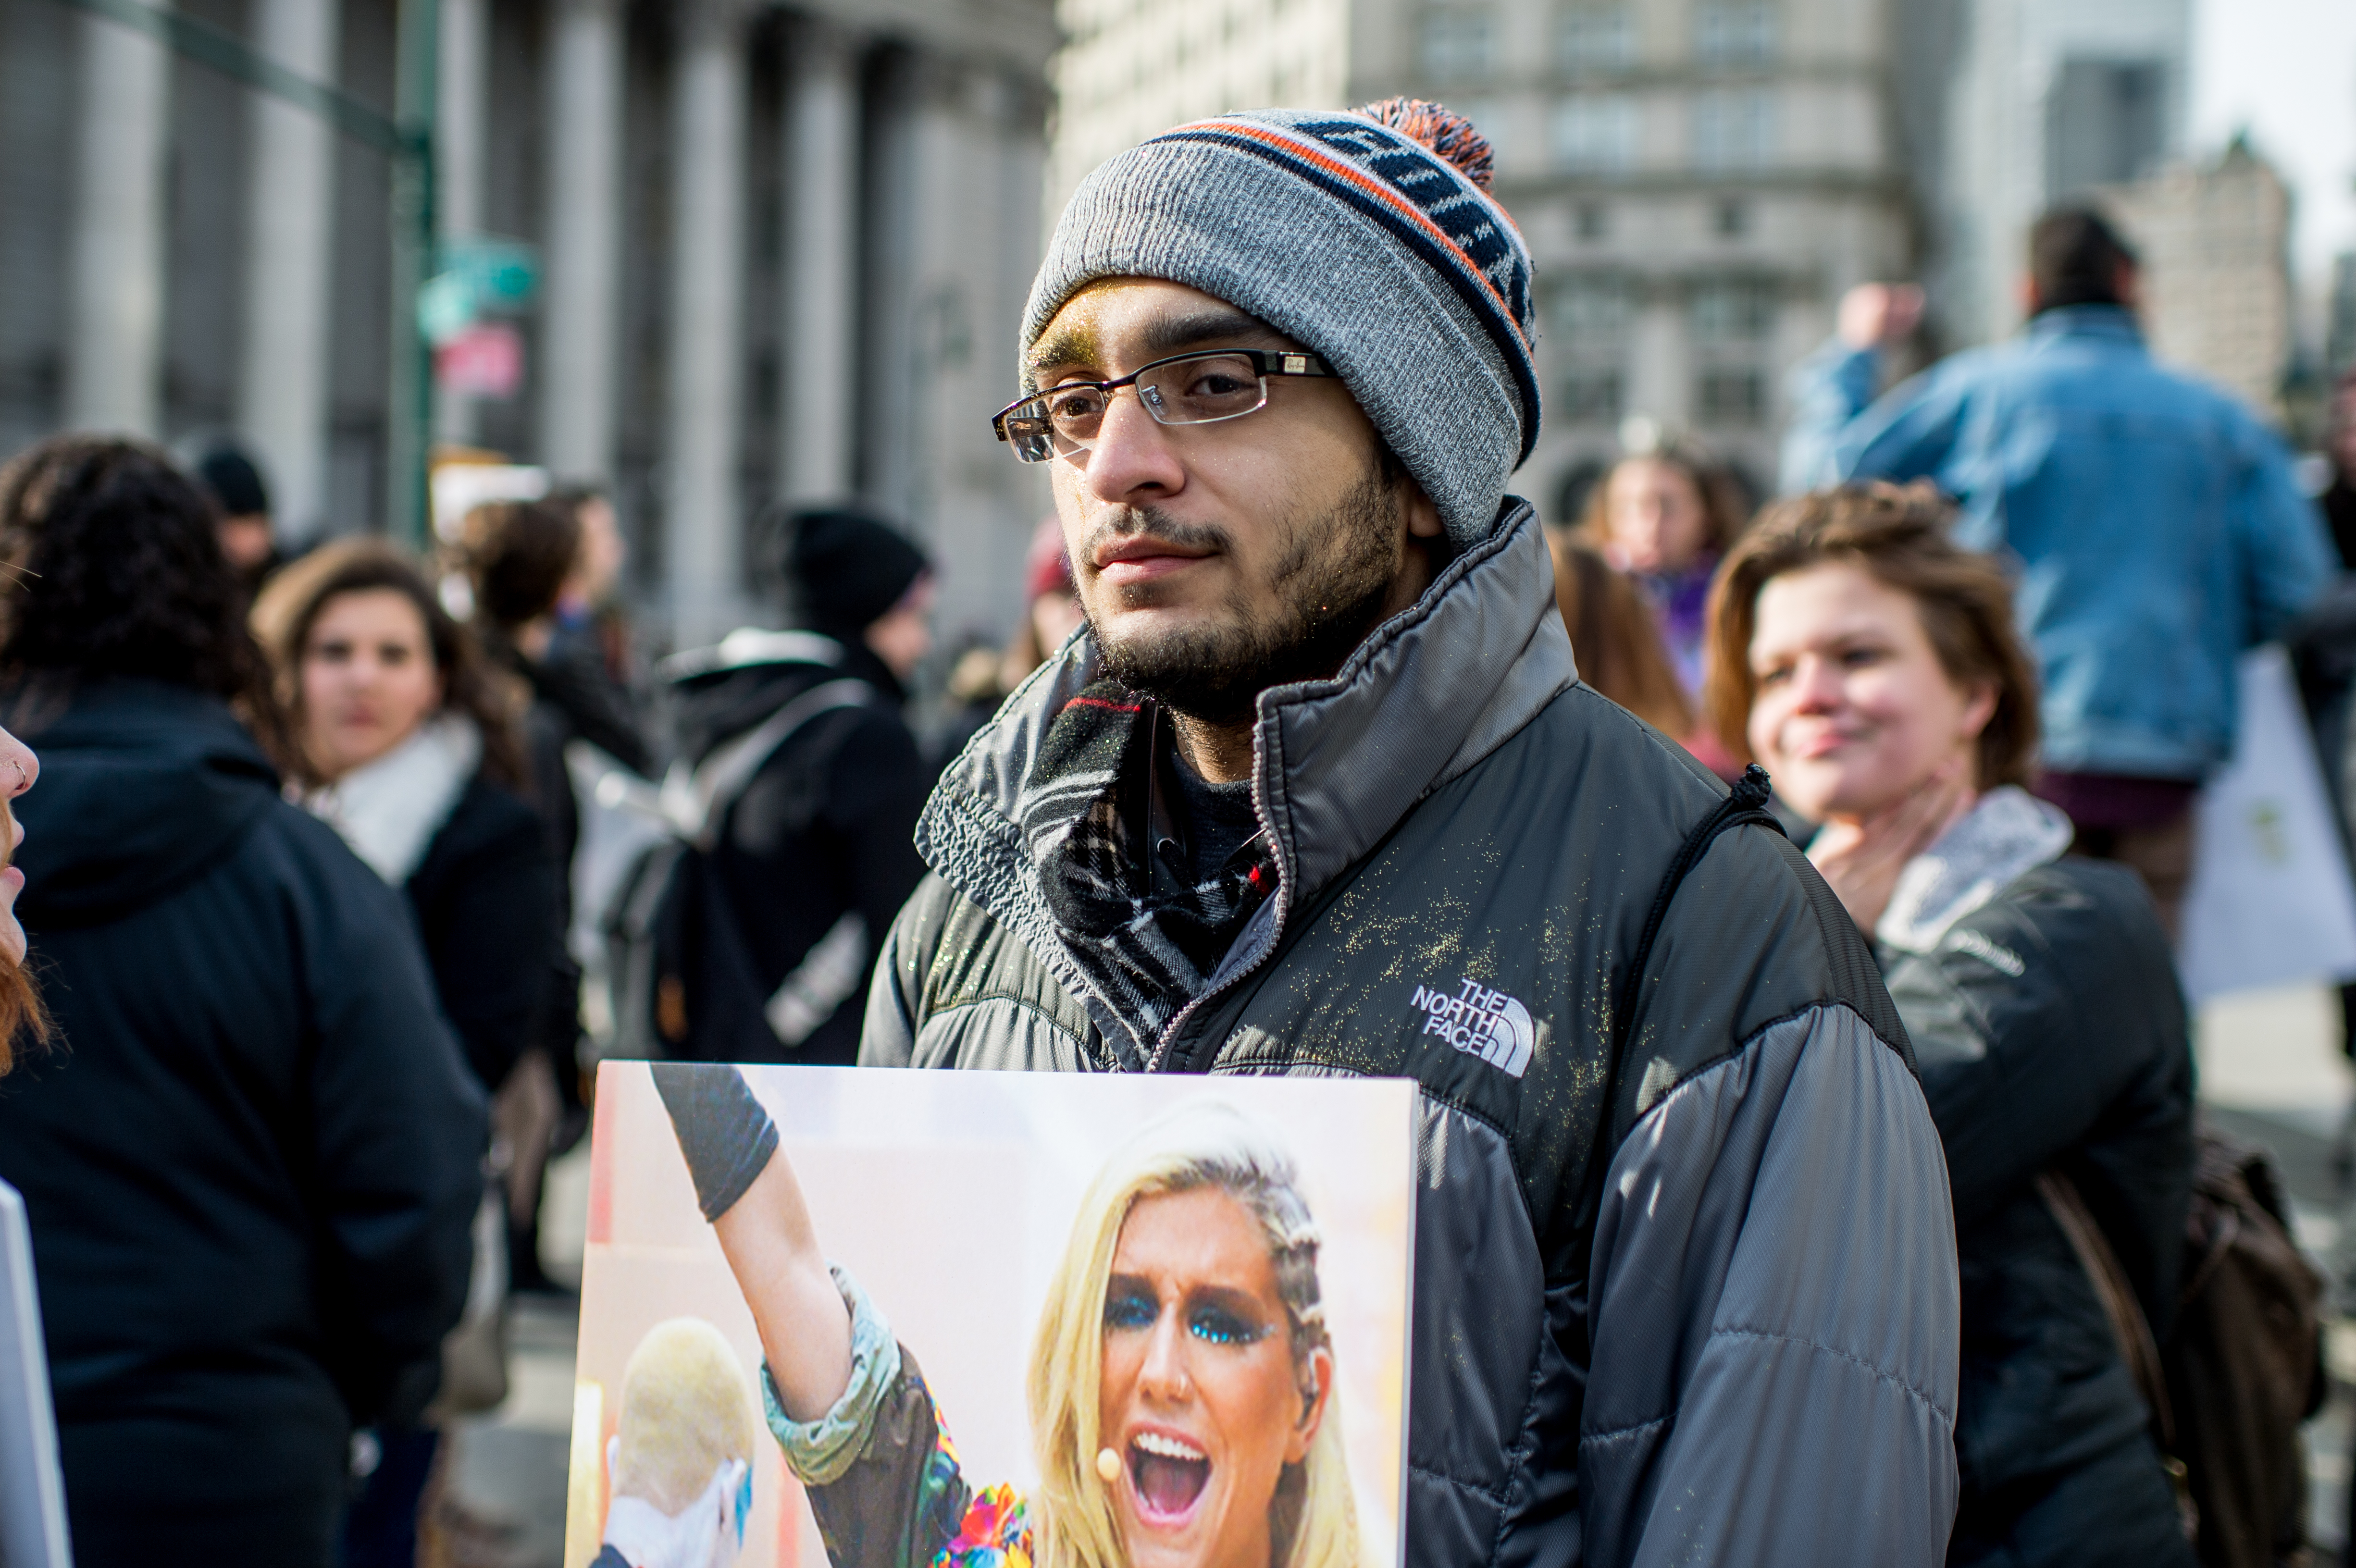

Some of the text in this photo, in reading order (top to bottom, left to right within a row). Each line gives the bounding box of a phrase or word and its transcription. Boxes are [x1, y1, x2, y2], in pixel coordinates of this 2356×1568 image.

[1410, 985, 1500, 1037] NORTH
[1461, 978, 1508, 1015] THE
[1423, 1015, 1488, 1056] FACE
